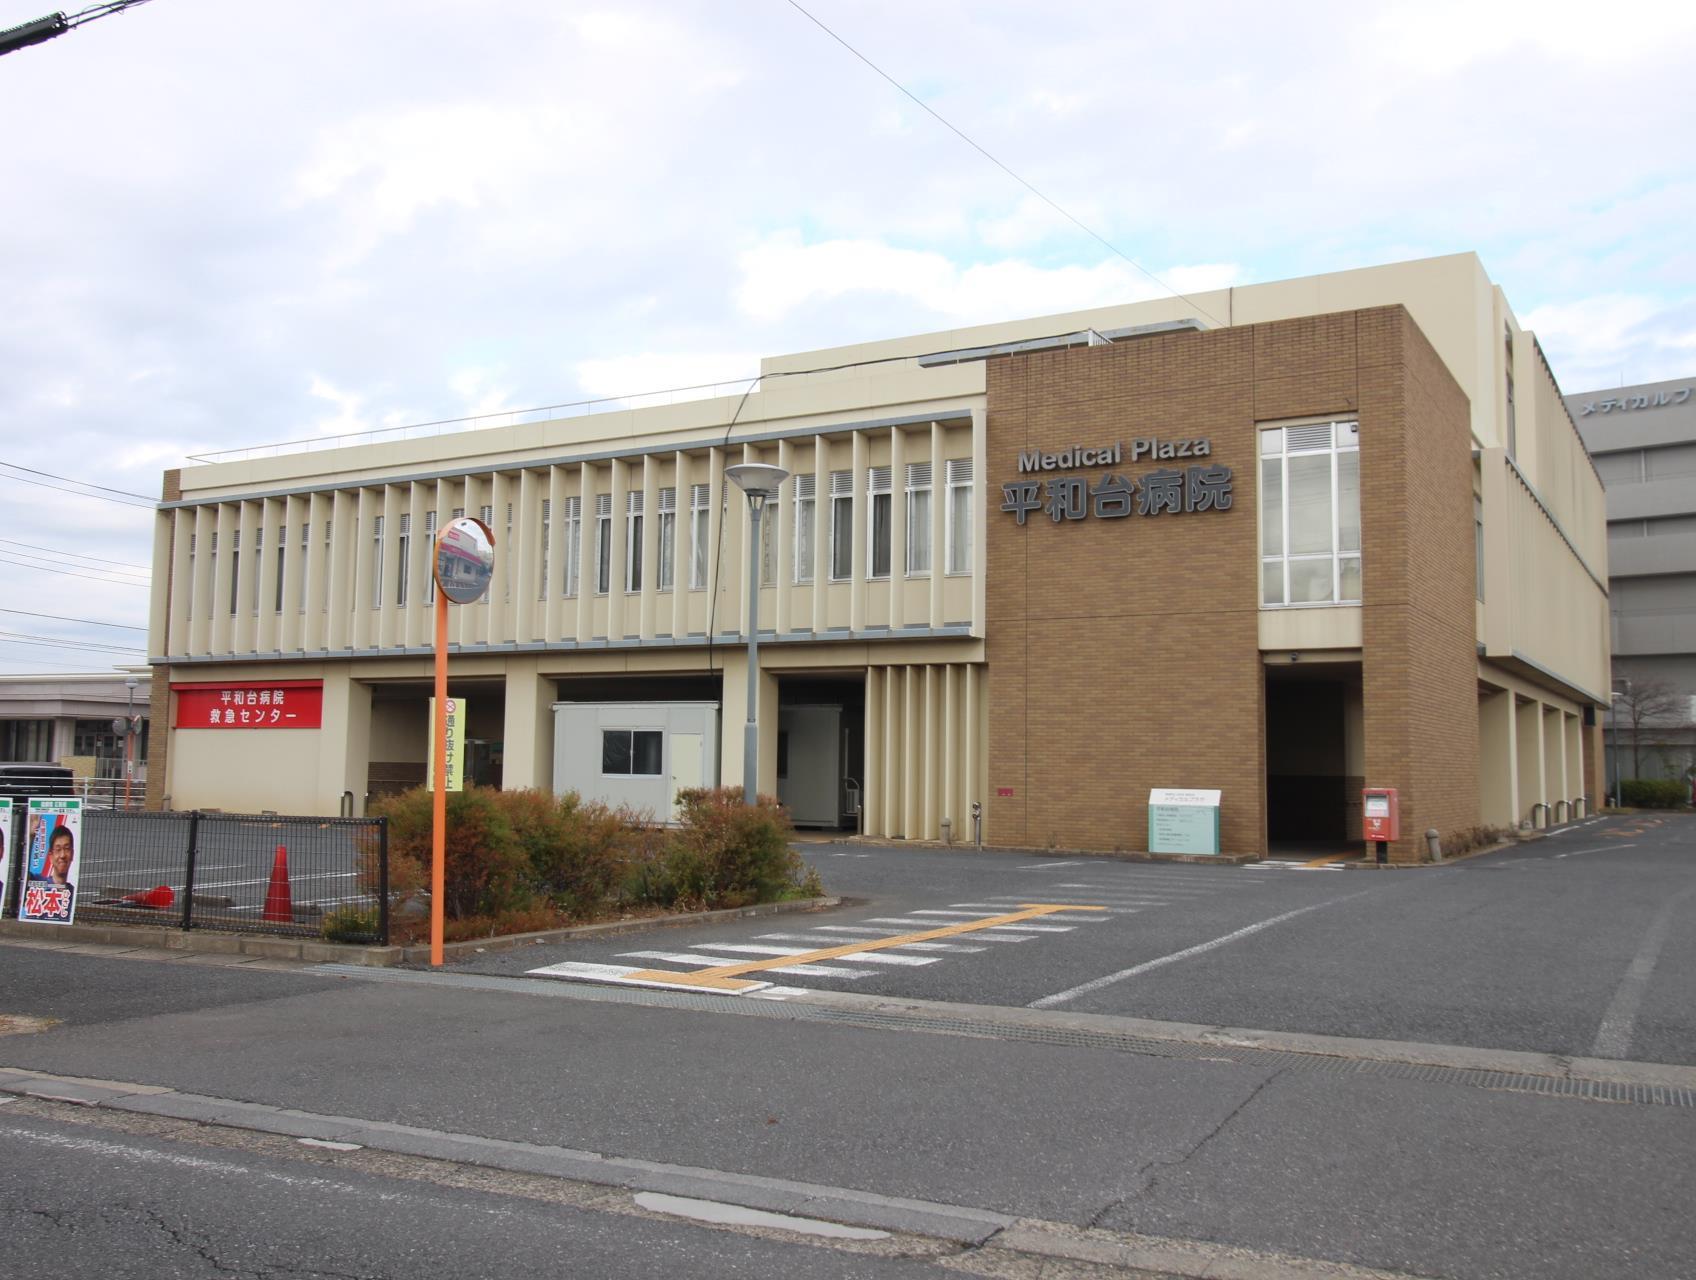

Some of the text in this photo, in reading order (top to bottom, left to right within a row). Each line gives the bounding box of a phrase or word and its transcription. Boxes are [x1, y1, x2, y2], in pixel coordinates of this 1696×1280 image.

[1017, 436, 1211, 473] Medical Plaza
[1000, 464, 1233, 526] 平和台病院
[221, 690, 285, 705] 平和台病院
[210, 708, 297, 724] 救急センター
[25, 887, 62, 917] 松本
[61, 889, 71, 918] ひさし
